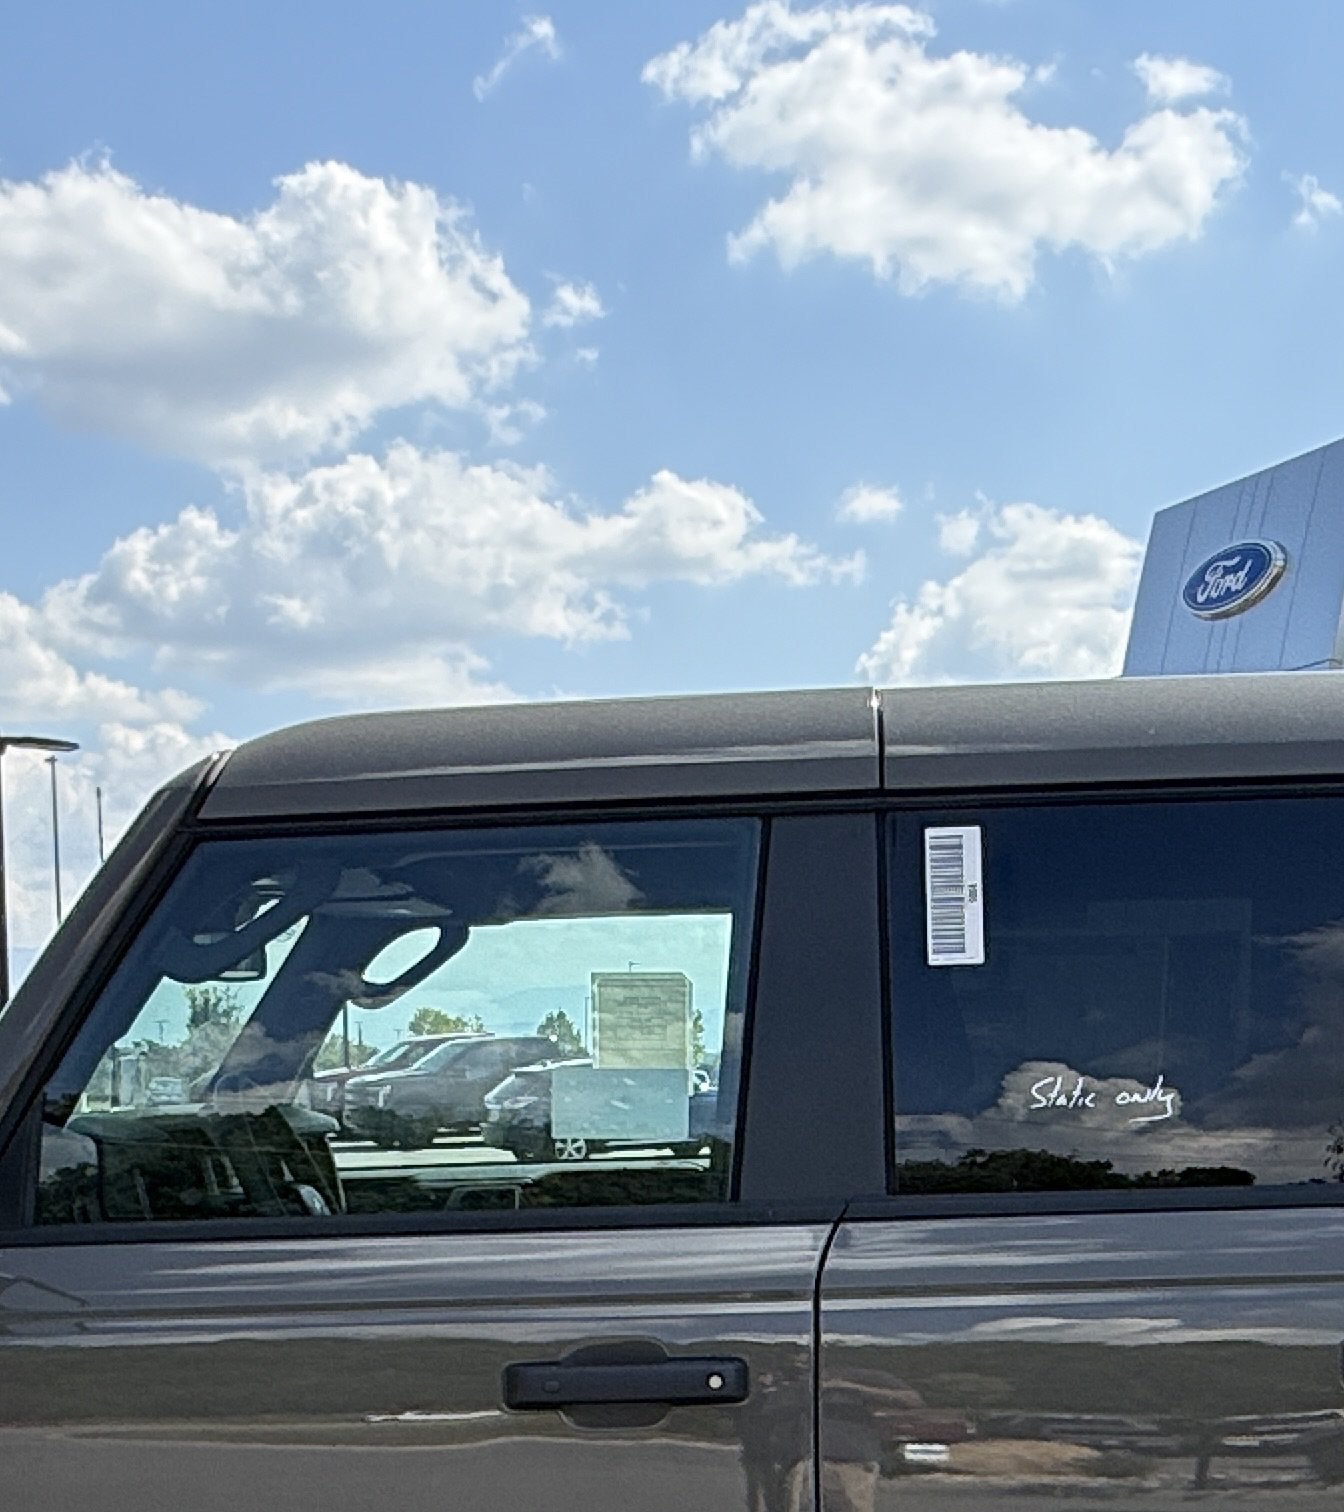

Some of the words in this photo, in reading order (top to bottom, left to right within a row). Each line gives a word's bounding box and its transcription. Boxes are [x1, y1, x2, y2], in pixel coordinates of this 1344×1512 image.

[1197, 555, 1253, 604] Ford
[1030, 1076, 1096, 1109] Static
[1115, 1074, 1175, 1124] only
